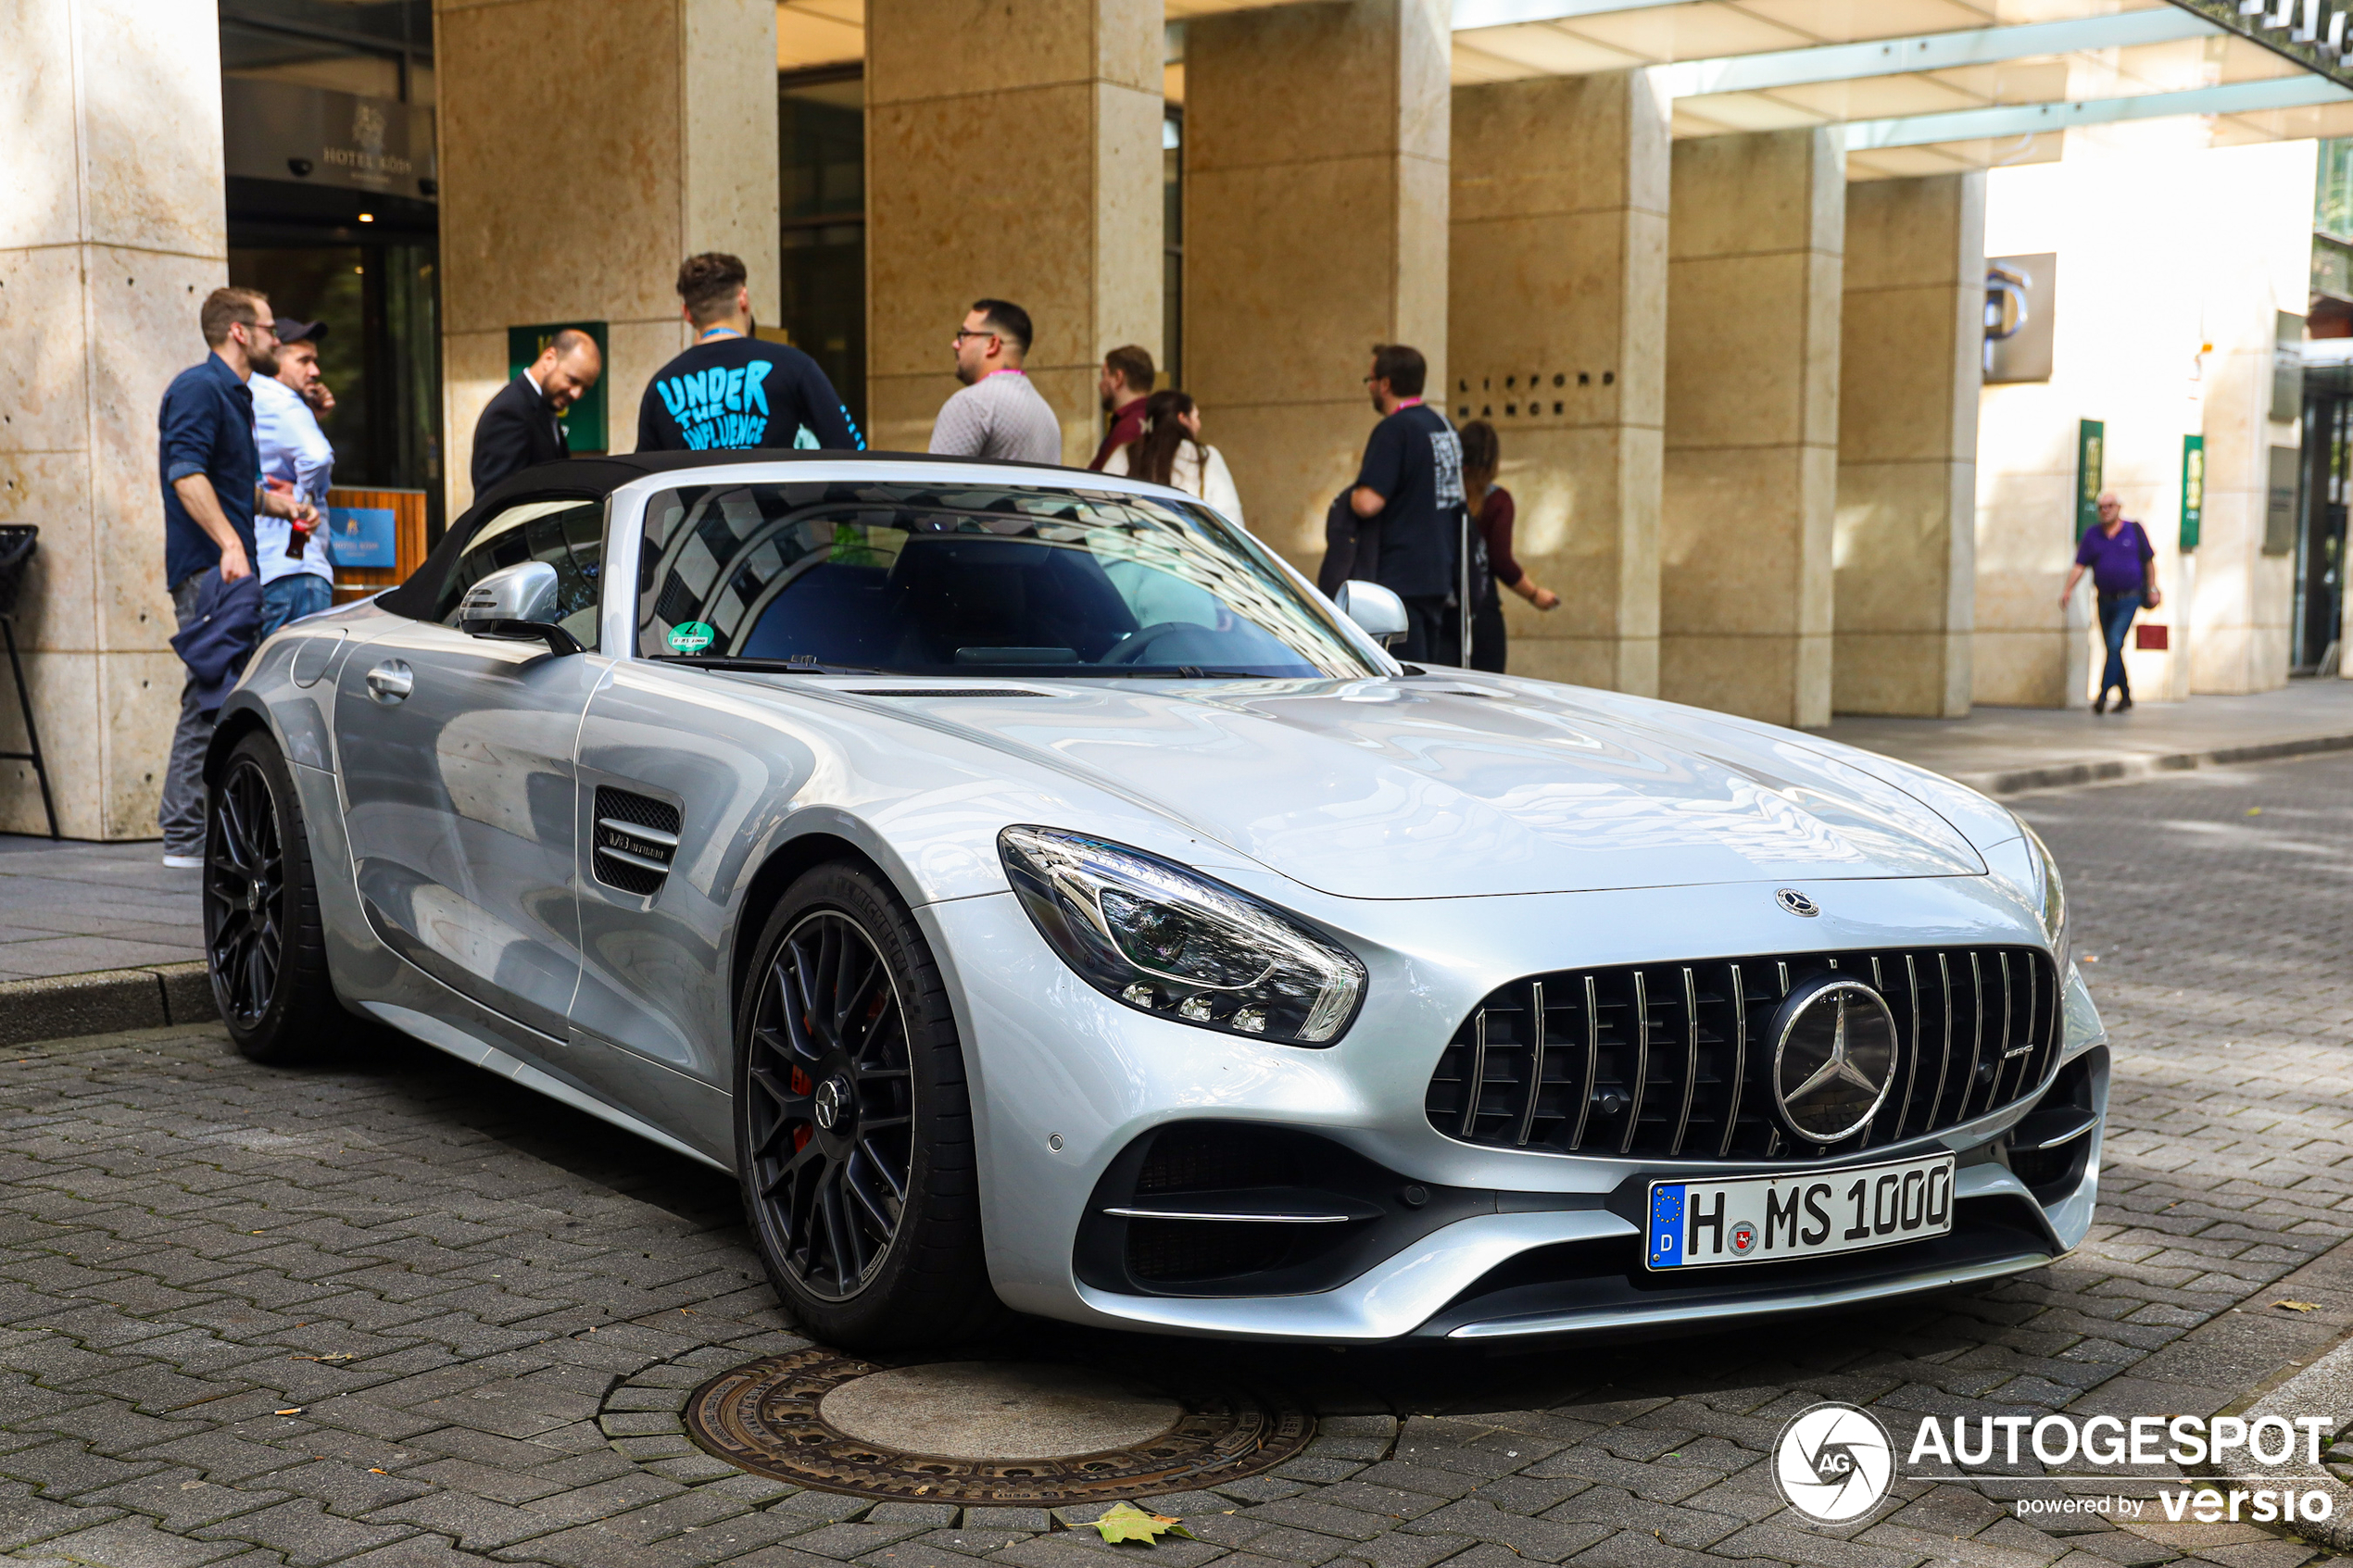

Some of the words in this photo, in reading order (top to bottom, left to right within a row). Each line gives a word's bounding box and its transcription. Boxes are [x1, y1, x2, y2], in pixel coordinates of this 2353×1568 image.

[323, 147, 372, 169] HOTEL
[656, 360, 774, 417] UNDER
[674, 402, 725, 430] THE
[682, 413, 768, 450] INFLUENCE
[685, 622, 698, 637] 4
[610, 832, 630, 849] V8
[850, 886, 907, 973] MICHELIN
[1688, 1191, 1726, 1256] H
[1764, 1183, 1832, 1249] MS
[1843, 1164, 1951, 1241] 1000
[1661, 1233, 1673, 1252] D
